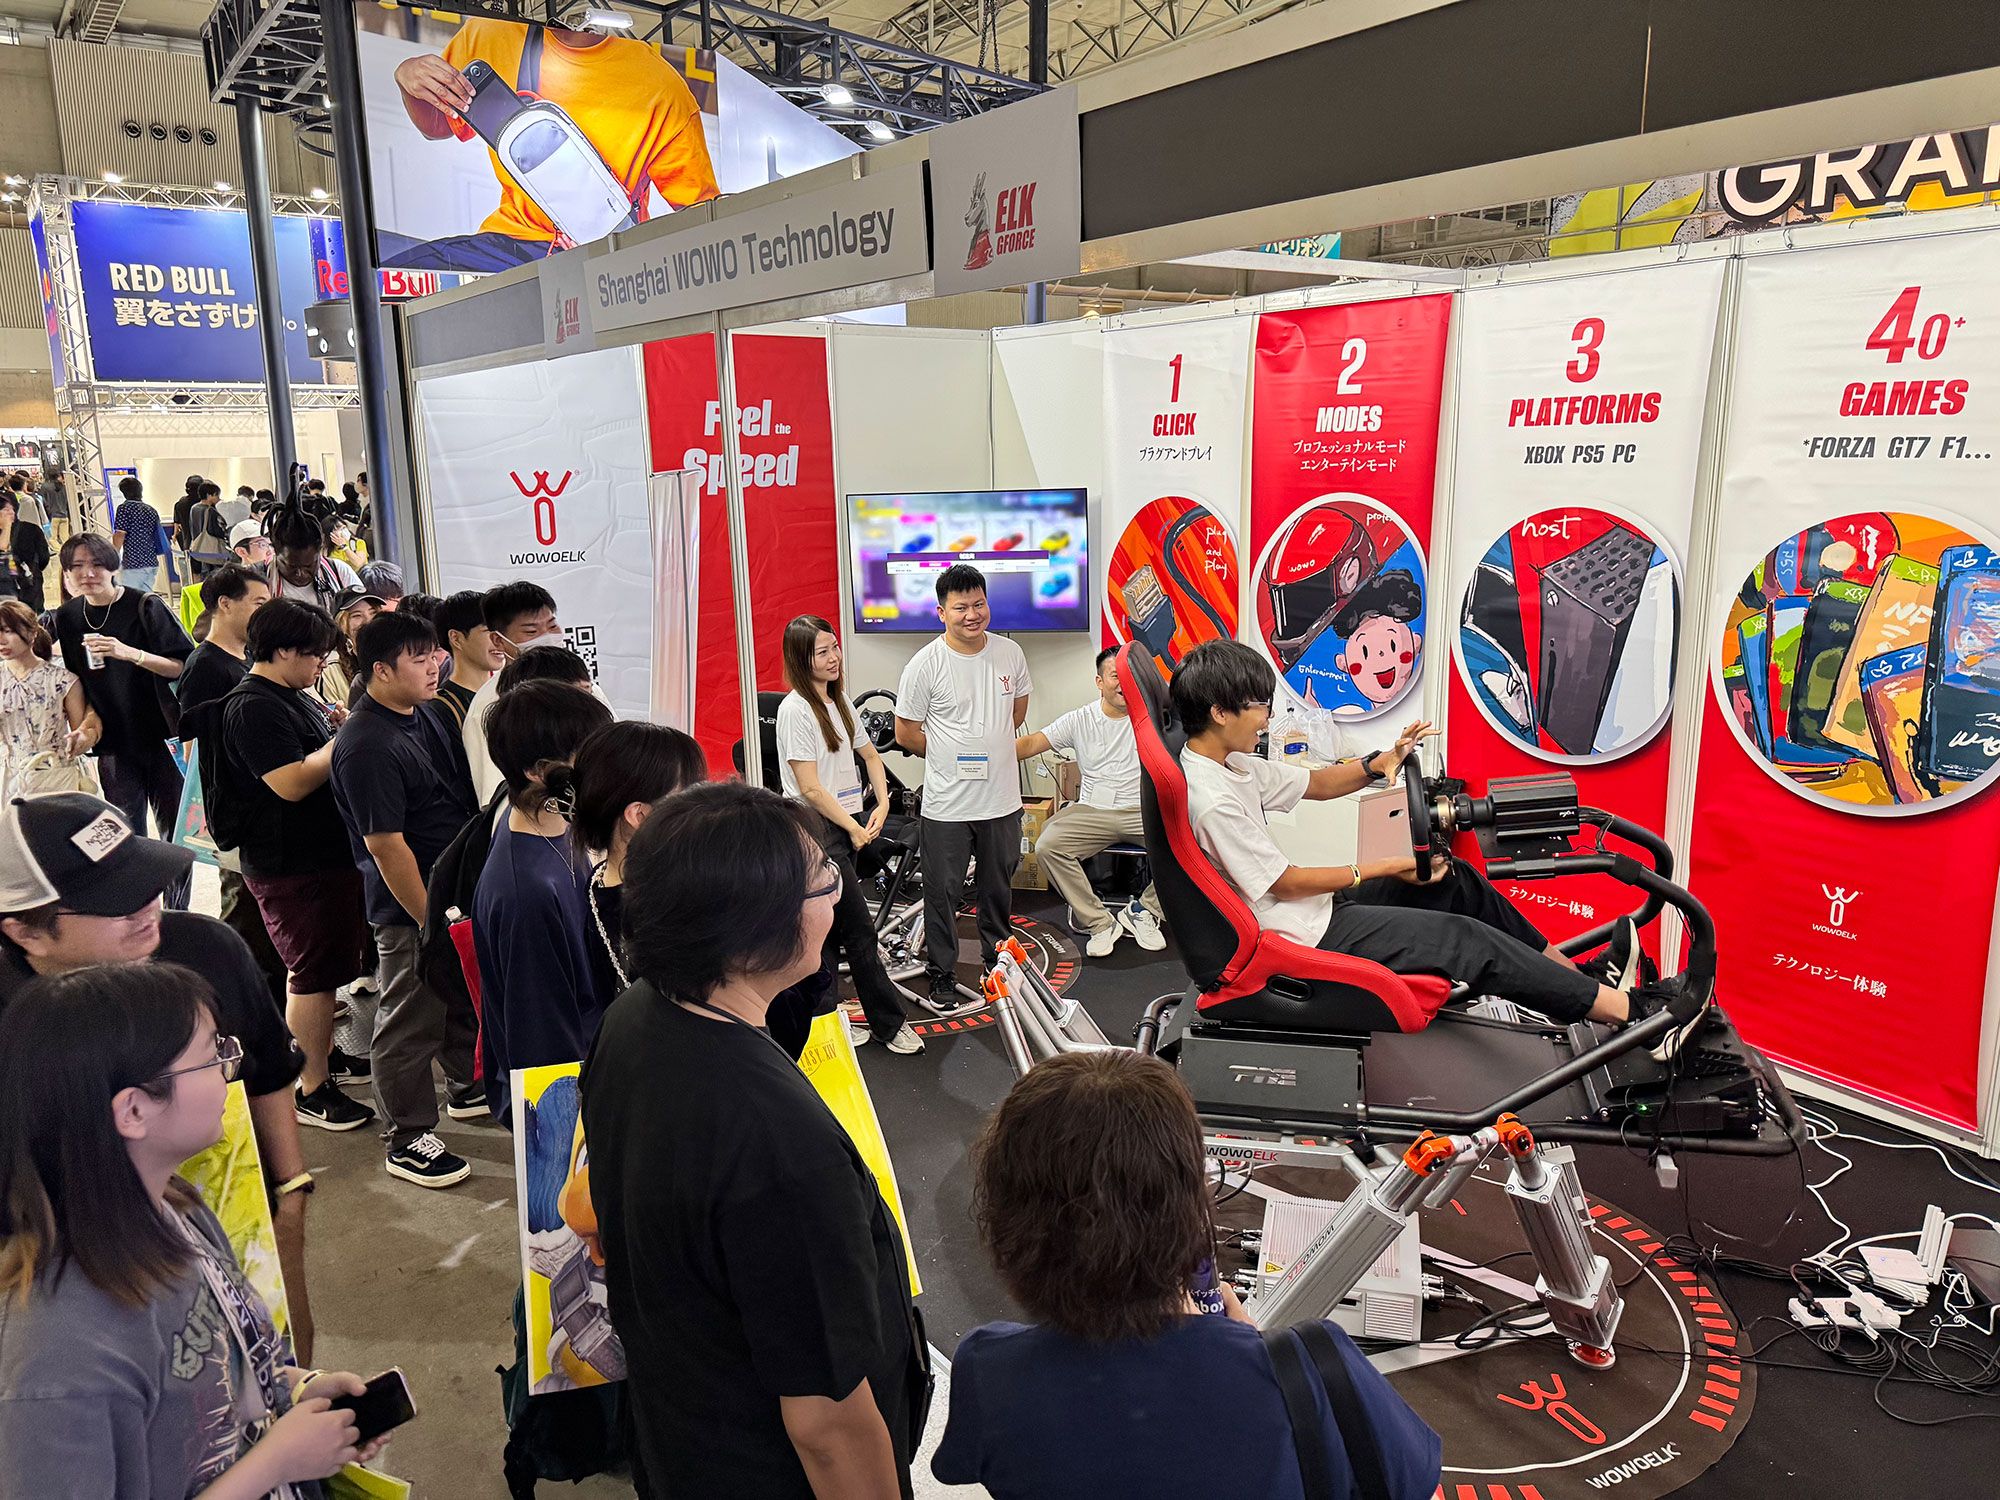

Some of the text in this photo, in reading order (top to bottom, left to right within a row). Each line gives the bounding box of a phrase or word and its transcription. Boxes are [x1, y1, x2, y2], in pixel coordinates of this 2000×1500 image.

[1723, 126, 2000, 217] GRA
[995, 182, 1037, 233] ELK
[996, 229, 1036, 255] GFORCE
[598, 208, 894, 308] Shanghai WOWO Technology
[109, 262, 235, 296] RED BULL
[317, 260, 350, 295] Re
[113, 298, 298, 330] 翼をさずけ。
[564, 297, 579, 323] ELK
[1566, 317, 1606, 383] 3
[1169, 354, 1182, 402] 1
[1336, 338, 1367, 395] 2
[1508, 392, 1662, 427] PLATFORMS
[1839, 379, 1969, 417] GAMES
[775, 423, 791, 434] the
[1153, 413, 1197, 437] CLICK
[1315, 405, 1383, 433] MODES
[1140, 446, 1212, 461] プラグアンドプレイ
[1293, 439, 1407, 454] プロフェッショナルモード
[1524, 444, 1637, 464] XBOX PS5 PC
[1887, 437, 1931, 458] GT7
[1300, 457, 1397, 472] エンターテインモード
[1522, 515, 1582, 539] host
[510, 550, 586, 565] WOWOELK
[1206, 547, 1222, 557] and
[1509, 886, 1594, 919] テクノロジー体験
[1812, 923, 1858, 940] WOWOELK
[1772, 953, 1887, 998] テクノロジー体験
[1206, 1147, 1278, 1161] WOWOELK
[1585, 1443, 1681, 1490] WOWOELK
